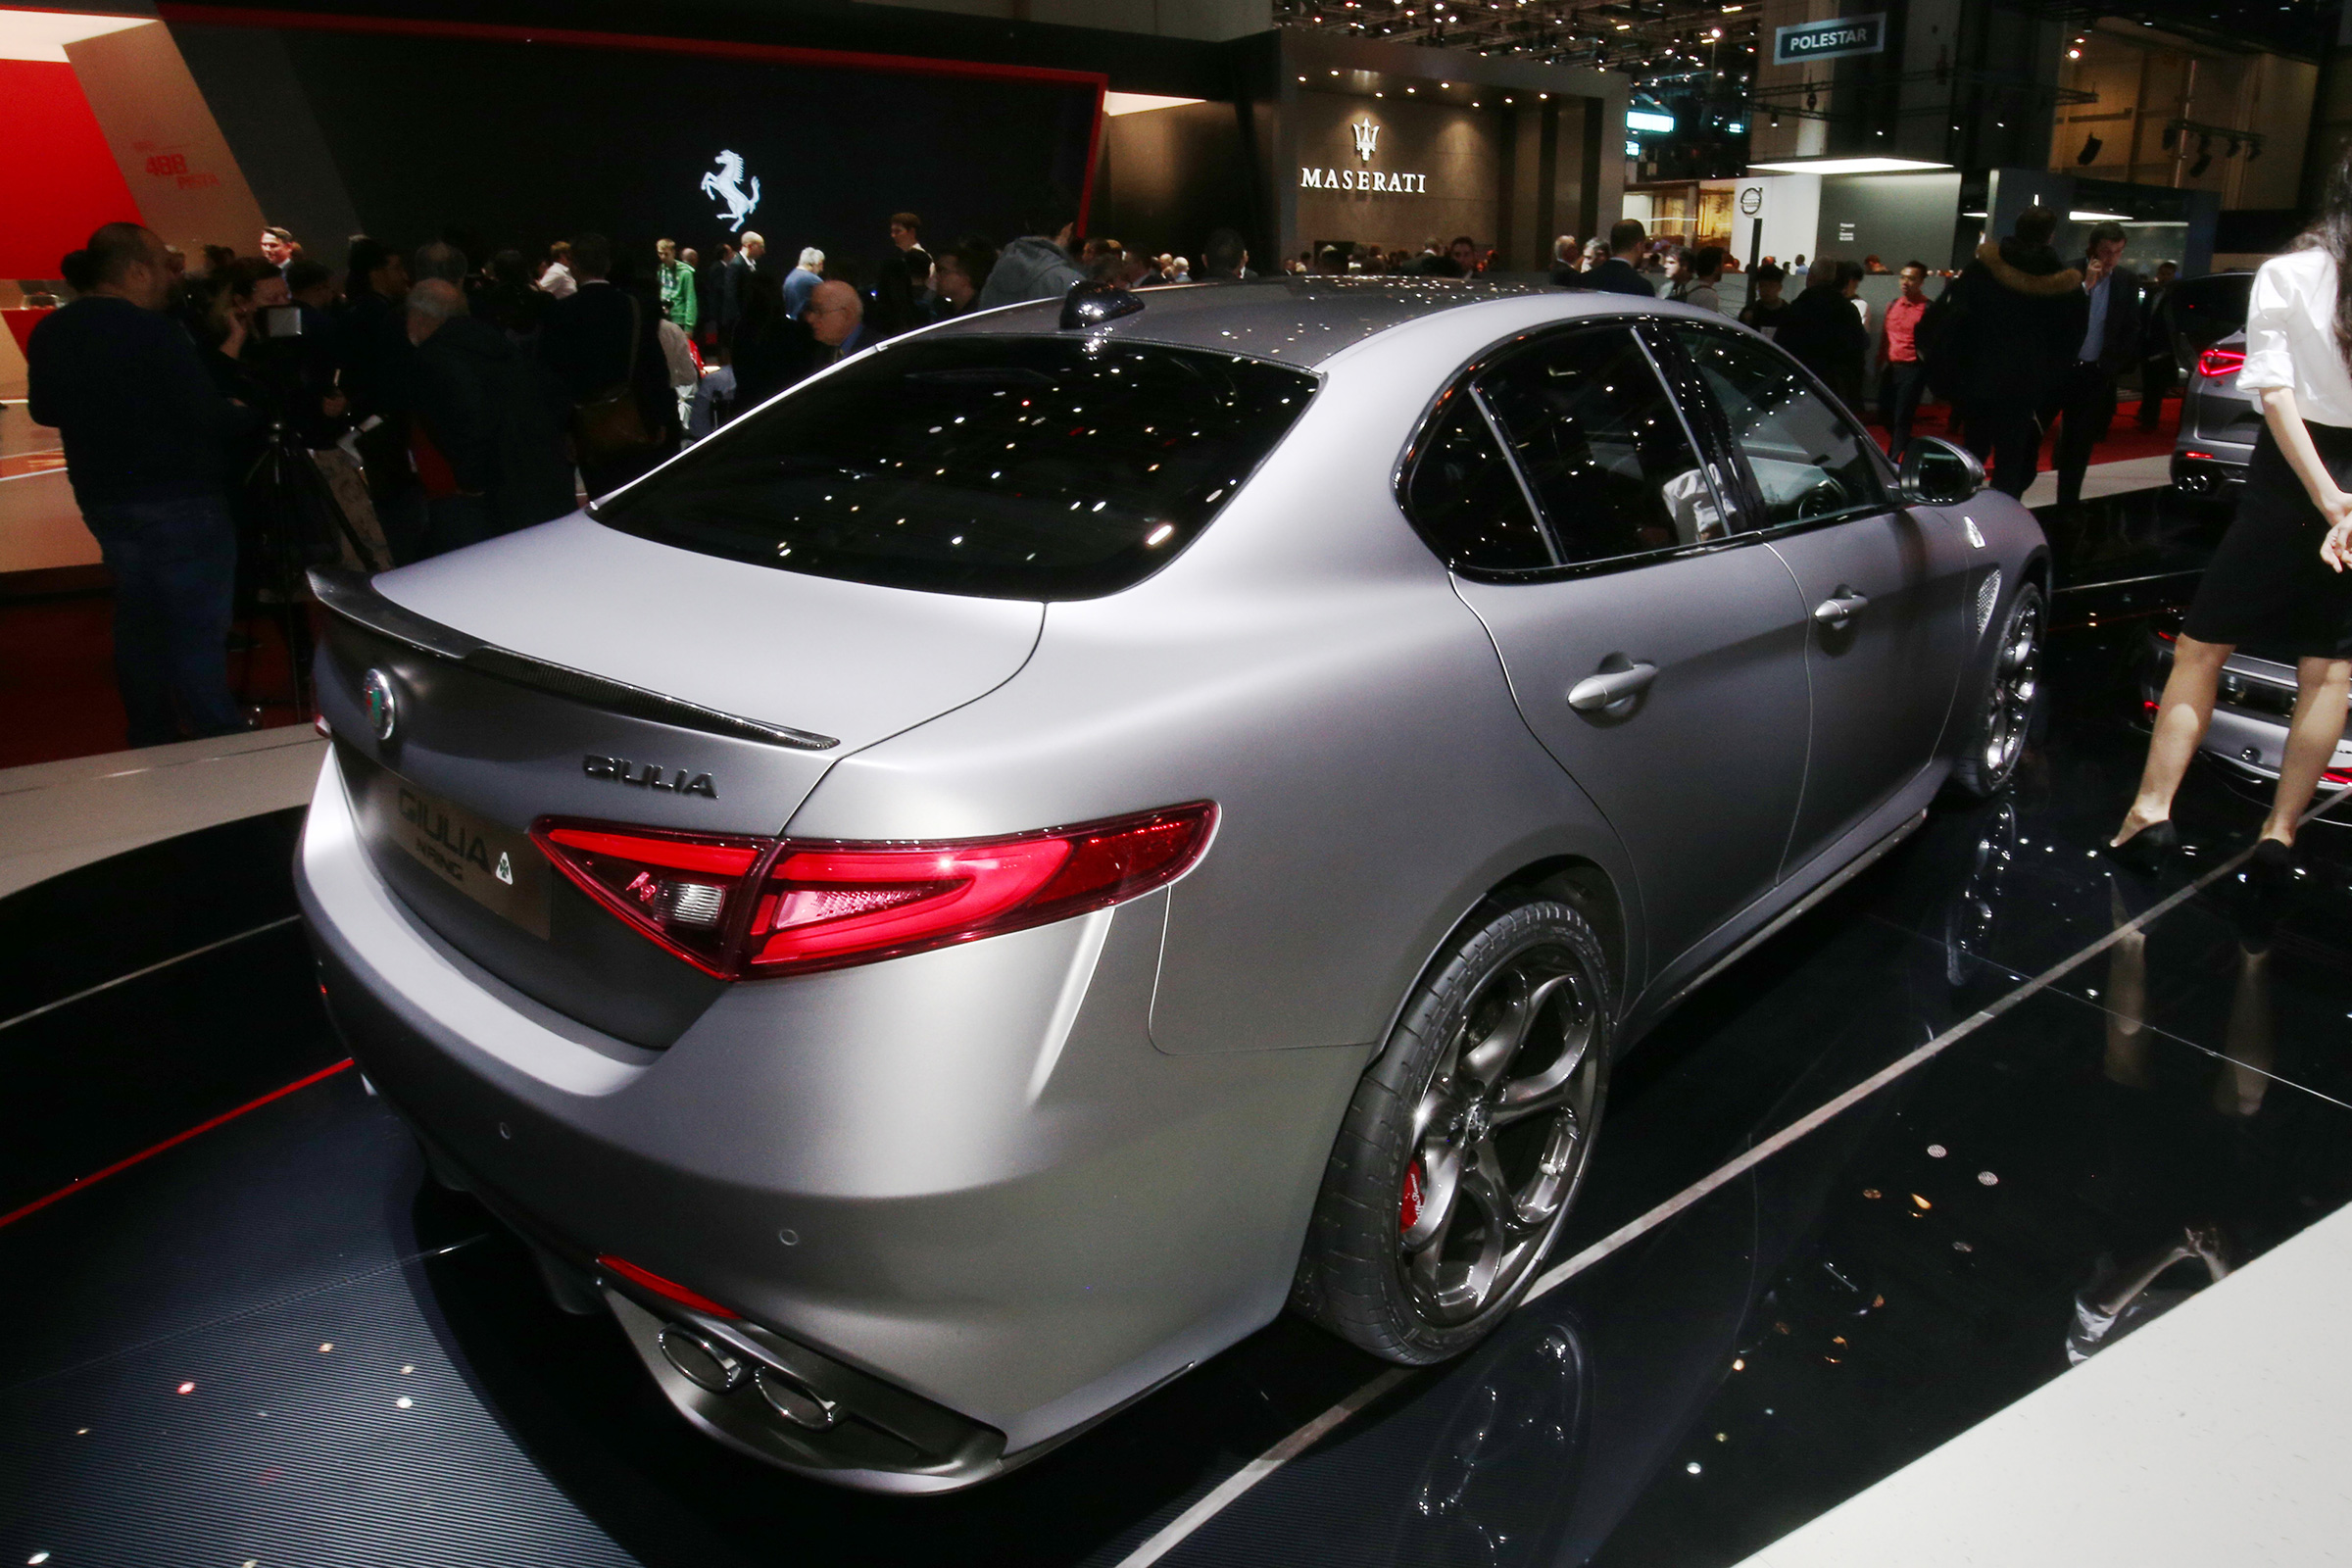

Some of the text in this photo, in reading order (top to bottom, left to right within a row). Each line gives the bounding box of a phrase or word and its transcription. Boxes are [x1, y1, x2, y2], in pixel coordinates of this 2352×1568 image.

[1789, 27, 1867, 51] POLESTAR
[145, 153, 188, 176] 488
[1299, 167, 1426, 193] MASERATI
[583, 754, 719, 800] GIULIA
[398, 787, 492, 875] GIULIA
